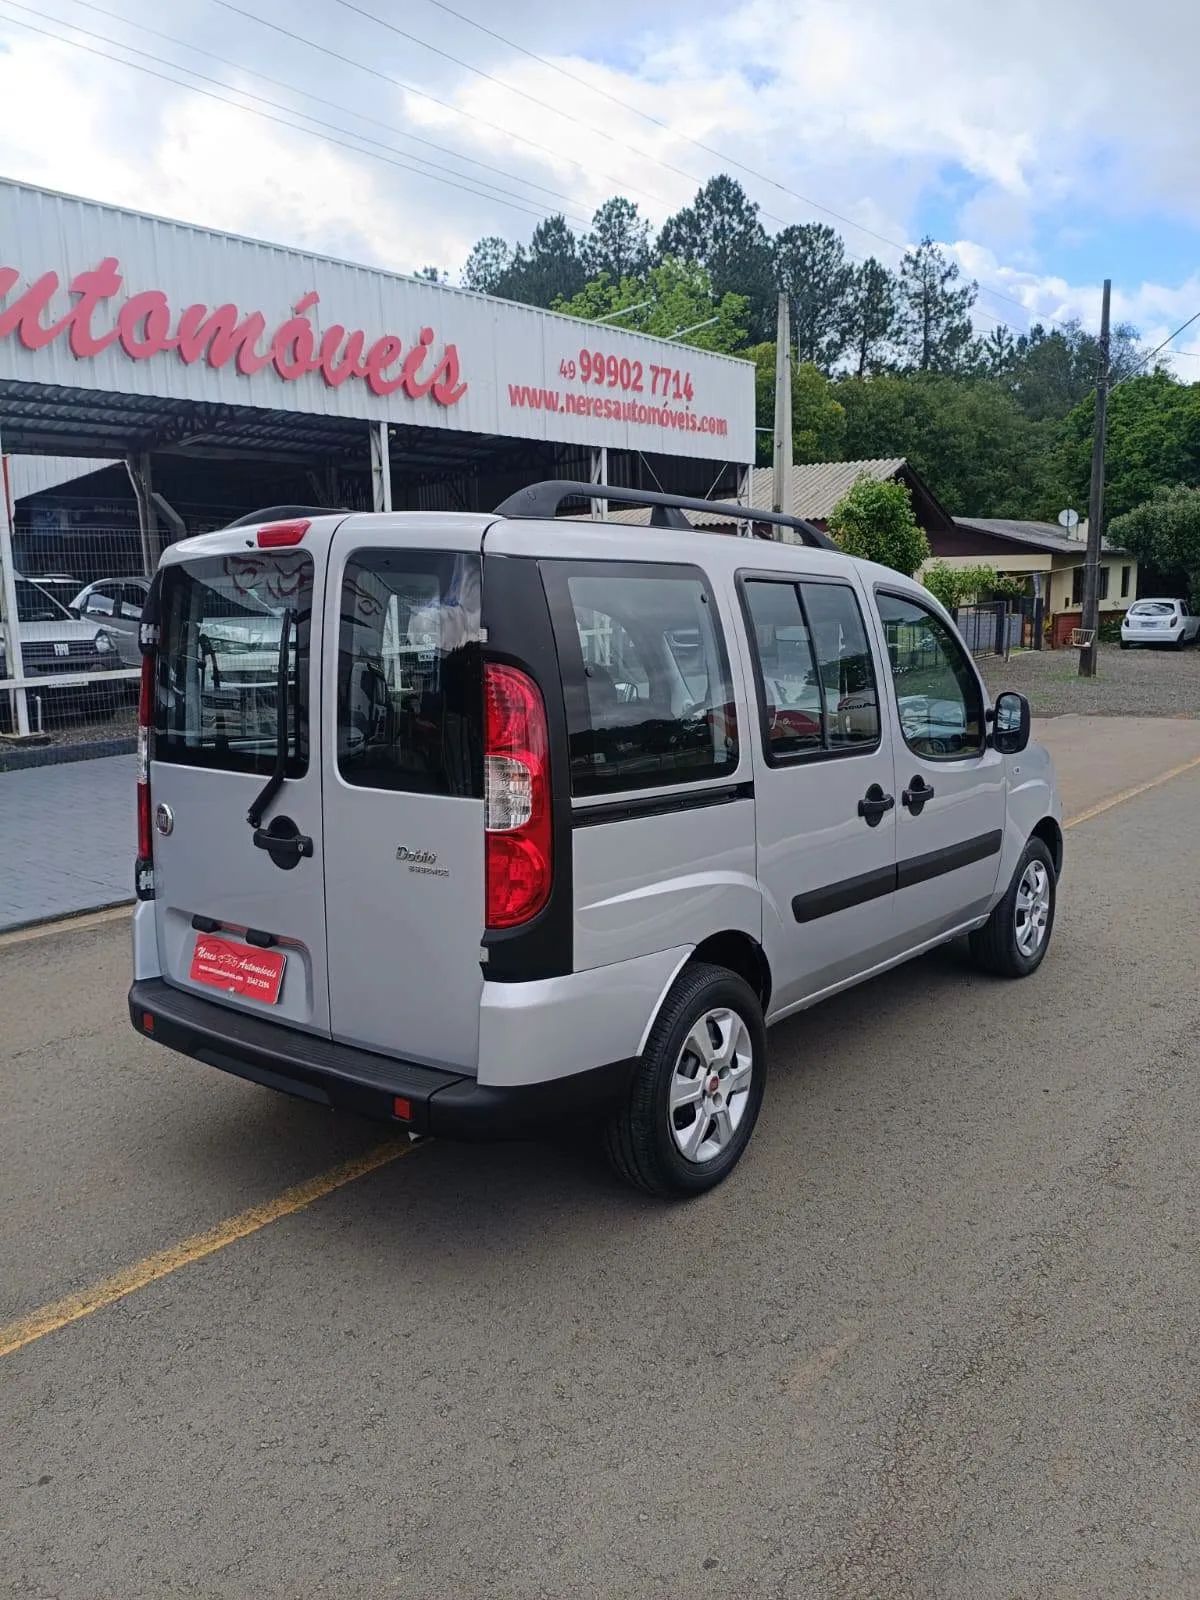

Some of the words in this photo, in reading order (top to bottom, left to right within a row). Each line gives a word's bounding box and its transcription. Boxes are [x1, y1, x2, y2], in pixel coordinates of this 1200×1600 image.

[559, 359, 576, 380] 49
[579, 348, 644, 392] 99902
[649, 363, 694, 401] 7714
[508, 383, 728, 436] www.neresautomóveis.com
